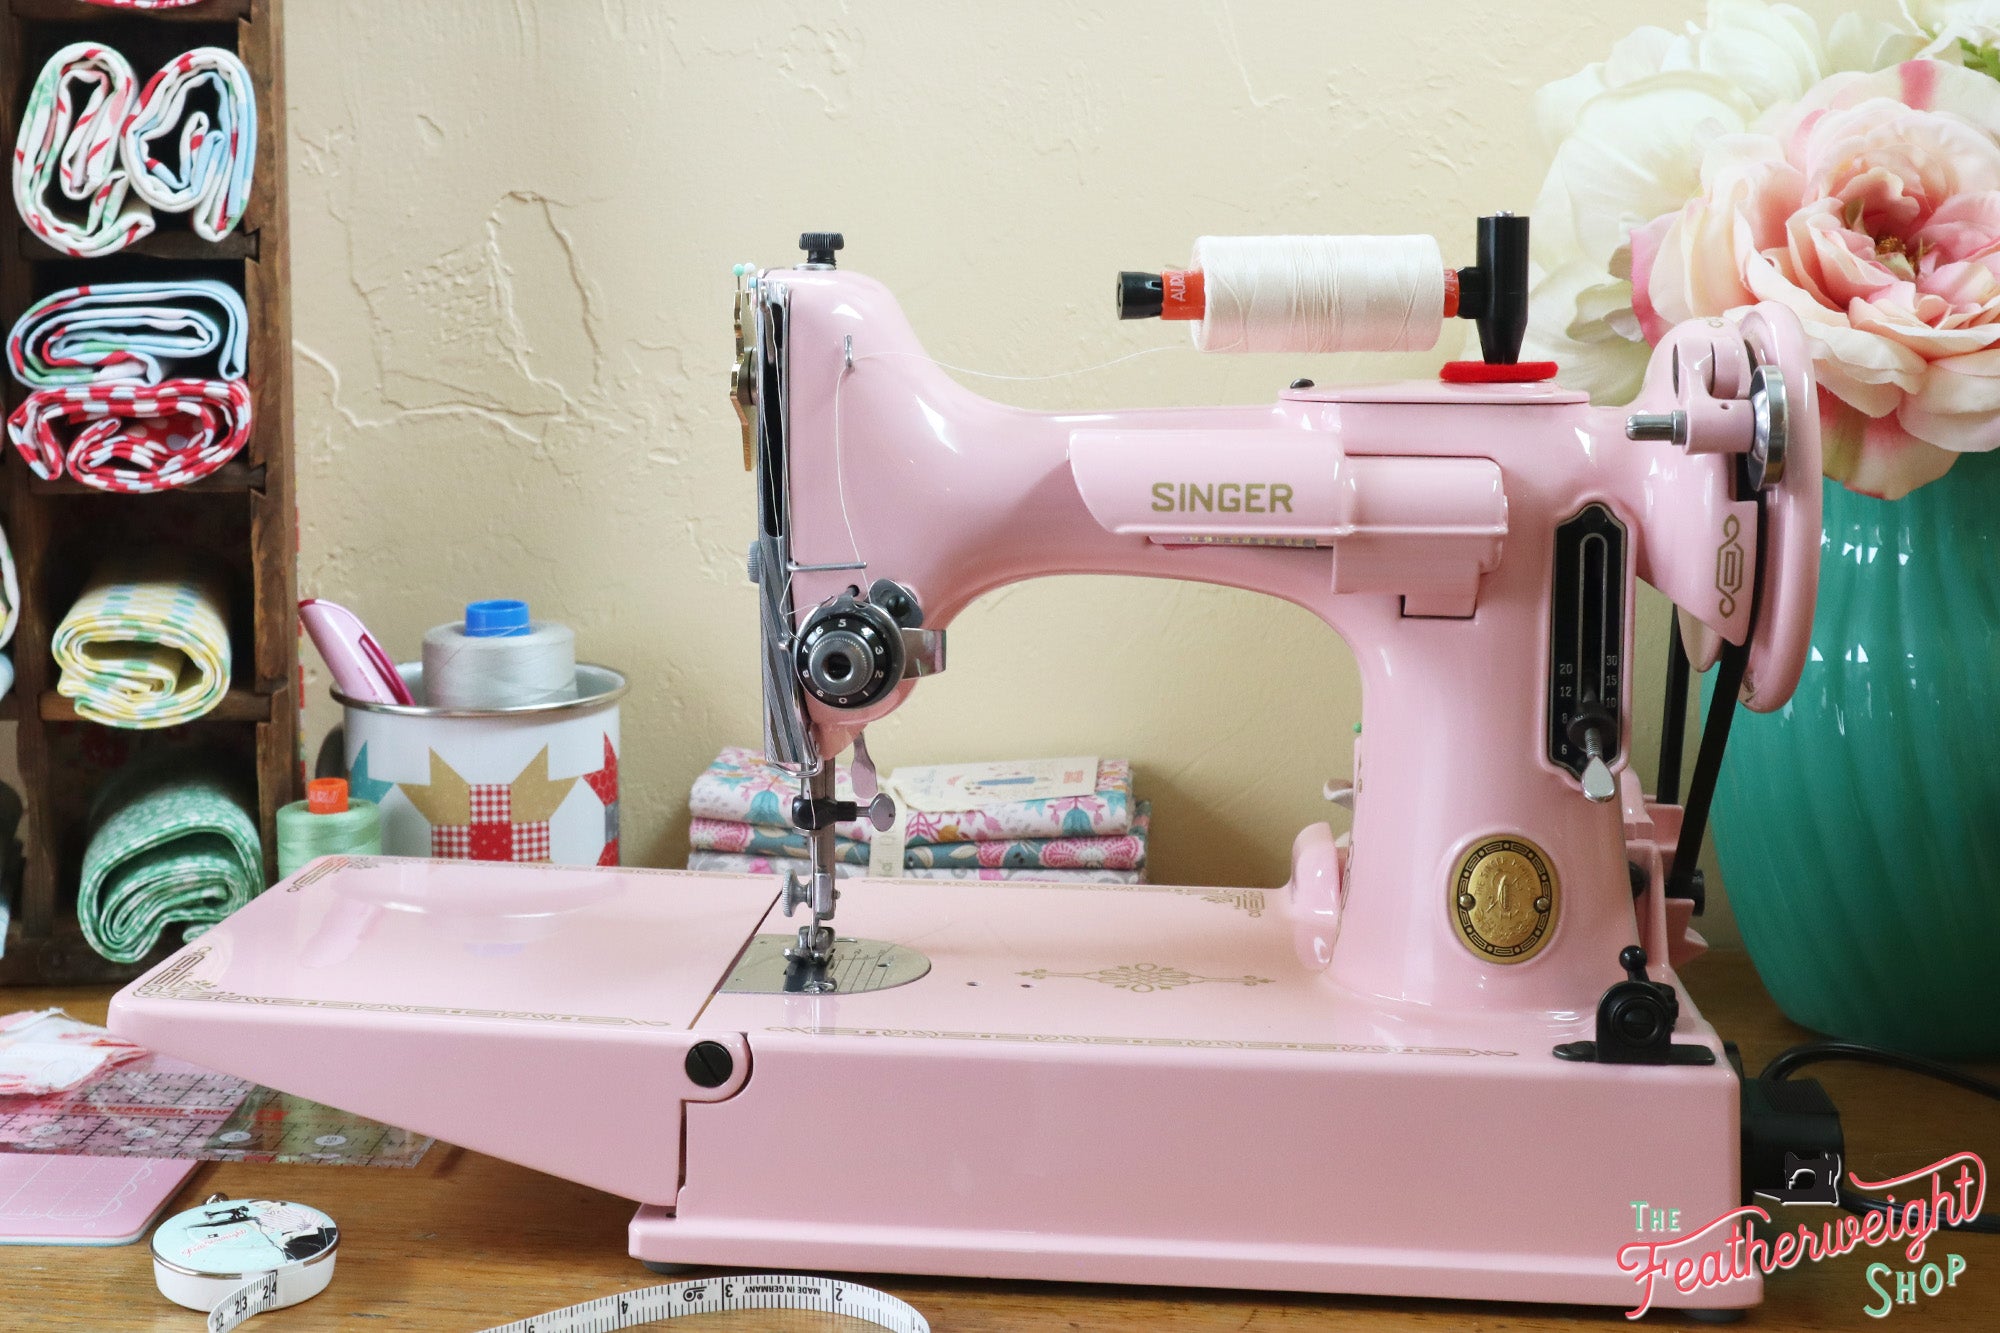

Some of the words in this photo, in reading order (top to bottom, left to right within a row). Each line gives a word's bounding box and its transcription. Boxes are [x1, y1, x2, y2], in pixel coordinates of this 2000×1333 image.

[1152, 482, 1293, 513] SINGER
[838, 619, 847, 628] 5
[815, 625, 824, 635] 6
[801, 645, 809, 654] 7
[875, 646, 884, 655] 3
[1606, 655, 1618, 666] 30
[875, 670, 884, 678] 2
[1560, 663, 1573, 674] 20
[1606, 675, 1618, 686] 15
[1560, 686, 1572, 697] 12
[1606, 697, 1617, 708] 10
[1561, 744, 1568, 755] 6
[191, 1107, 233, 1116] SHOP
[263, 1282, 277, 1300] 24
[725, 1284, 734, 1298] 3
[744, 1285, 785, 1294] GERMANY
[786, 1286, 796, 1294] IN
[797, 1286, 821, 1296] MADE
[835, 1288, 843, 1301] 2
[235, 1296, 248, 1316] 23
[621, 1301, 629, 1315] 4
